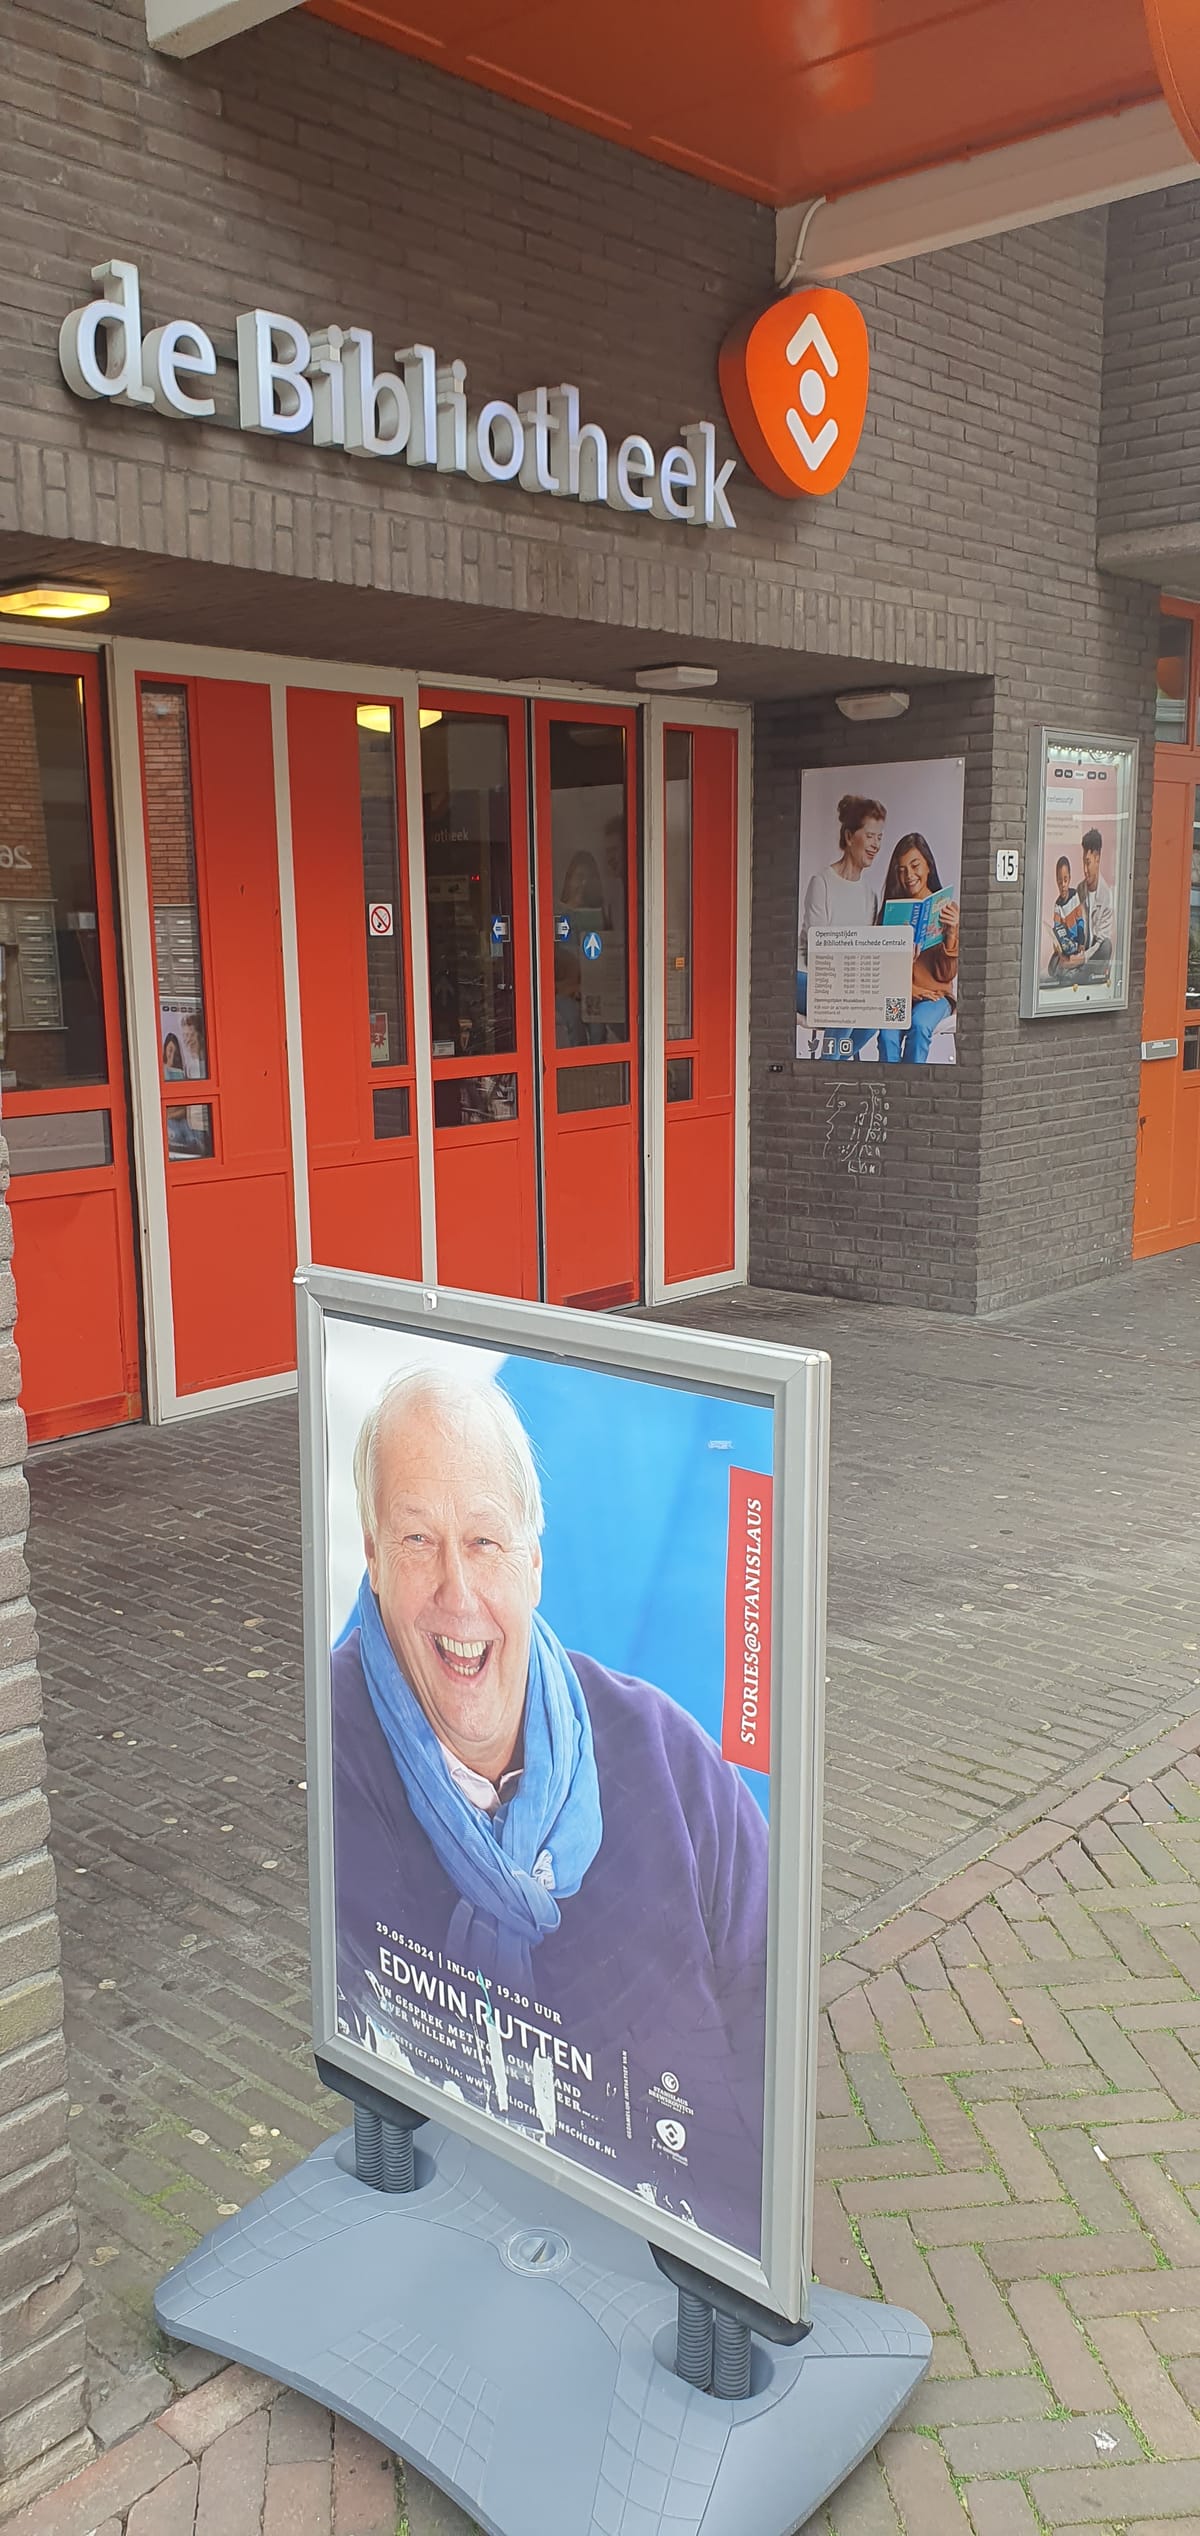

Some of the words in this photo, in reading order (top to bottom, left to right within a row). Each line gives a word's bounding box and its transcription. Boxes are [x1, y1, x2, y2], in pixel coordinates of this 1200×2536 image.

[59, 258, 217, 419] de
[236, 308, 738, 530] Bibliotheek
[1002, 855, 1015, 876] 15
[815, 930, 858, 938] Openingstijden
[823, 939, 854, 947] Bibliotheek
[882, 938, 907, 946] Centrale
[740, 1497, 762, 1745] STORIES@STANISLAUS
[376, 1921, 435, 1962] 29.05.2024
[446, 1959, 493, 1990] INLOOP
[497, 1985, 530, 2008] 19.30
[534, 2002, 562, 2025] UUR
[379, 1946, 468, 2018] EDWIN
[475, 1998, 593, 2081] RUTTEN
[395, 1994, 444, 2030] GESPREK
[448, 2023, 473, 2044] MET
[411, 2016, 457, 2050] WILLEM
